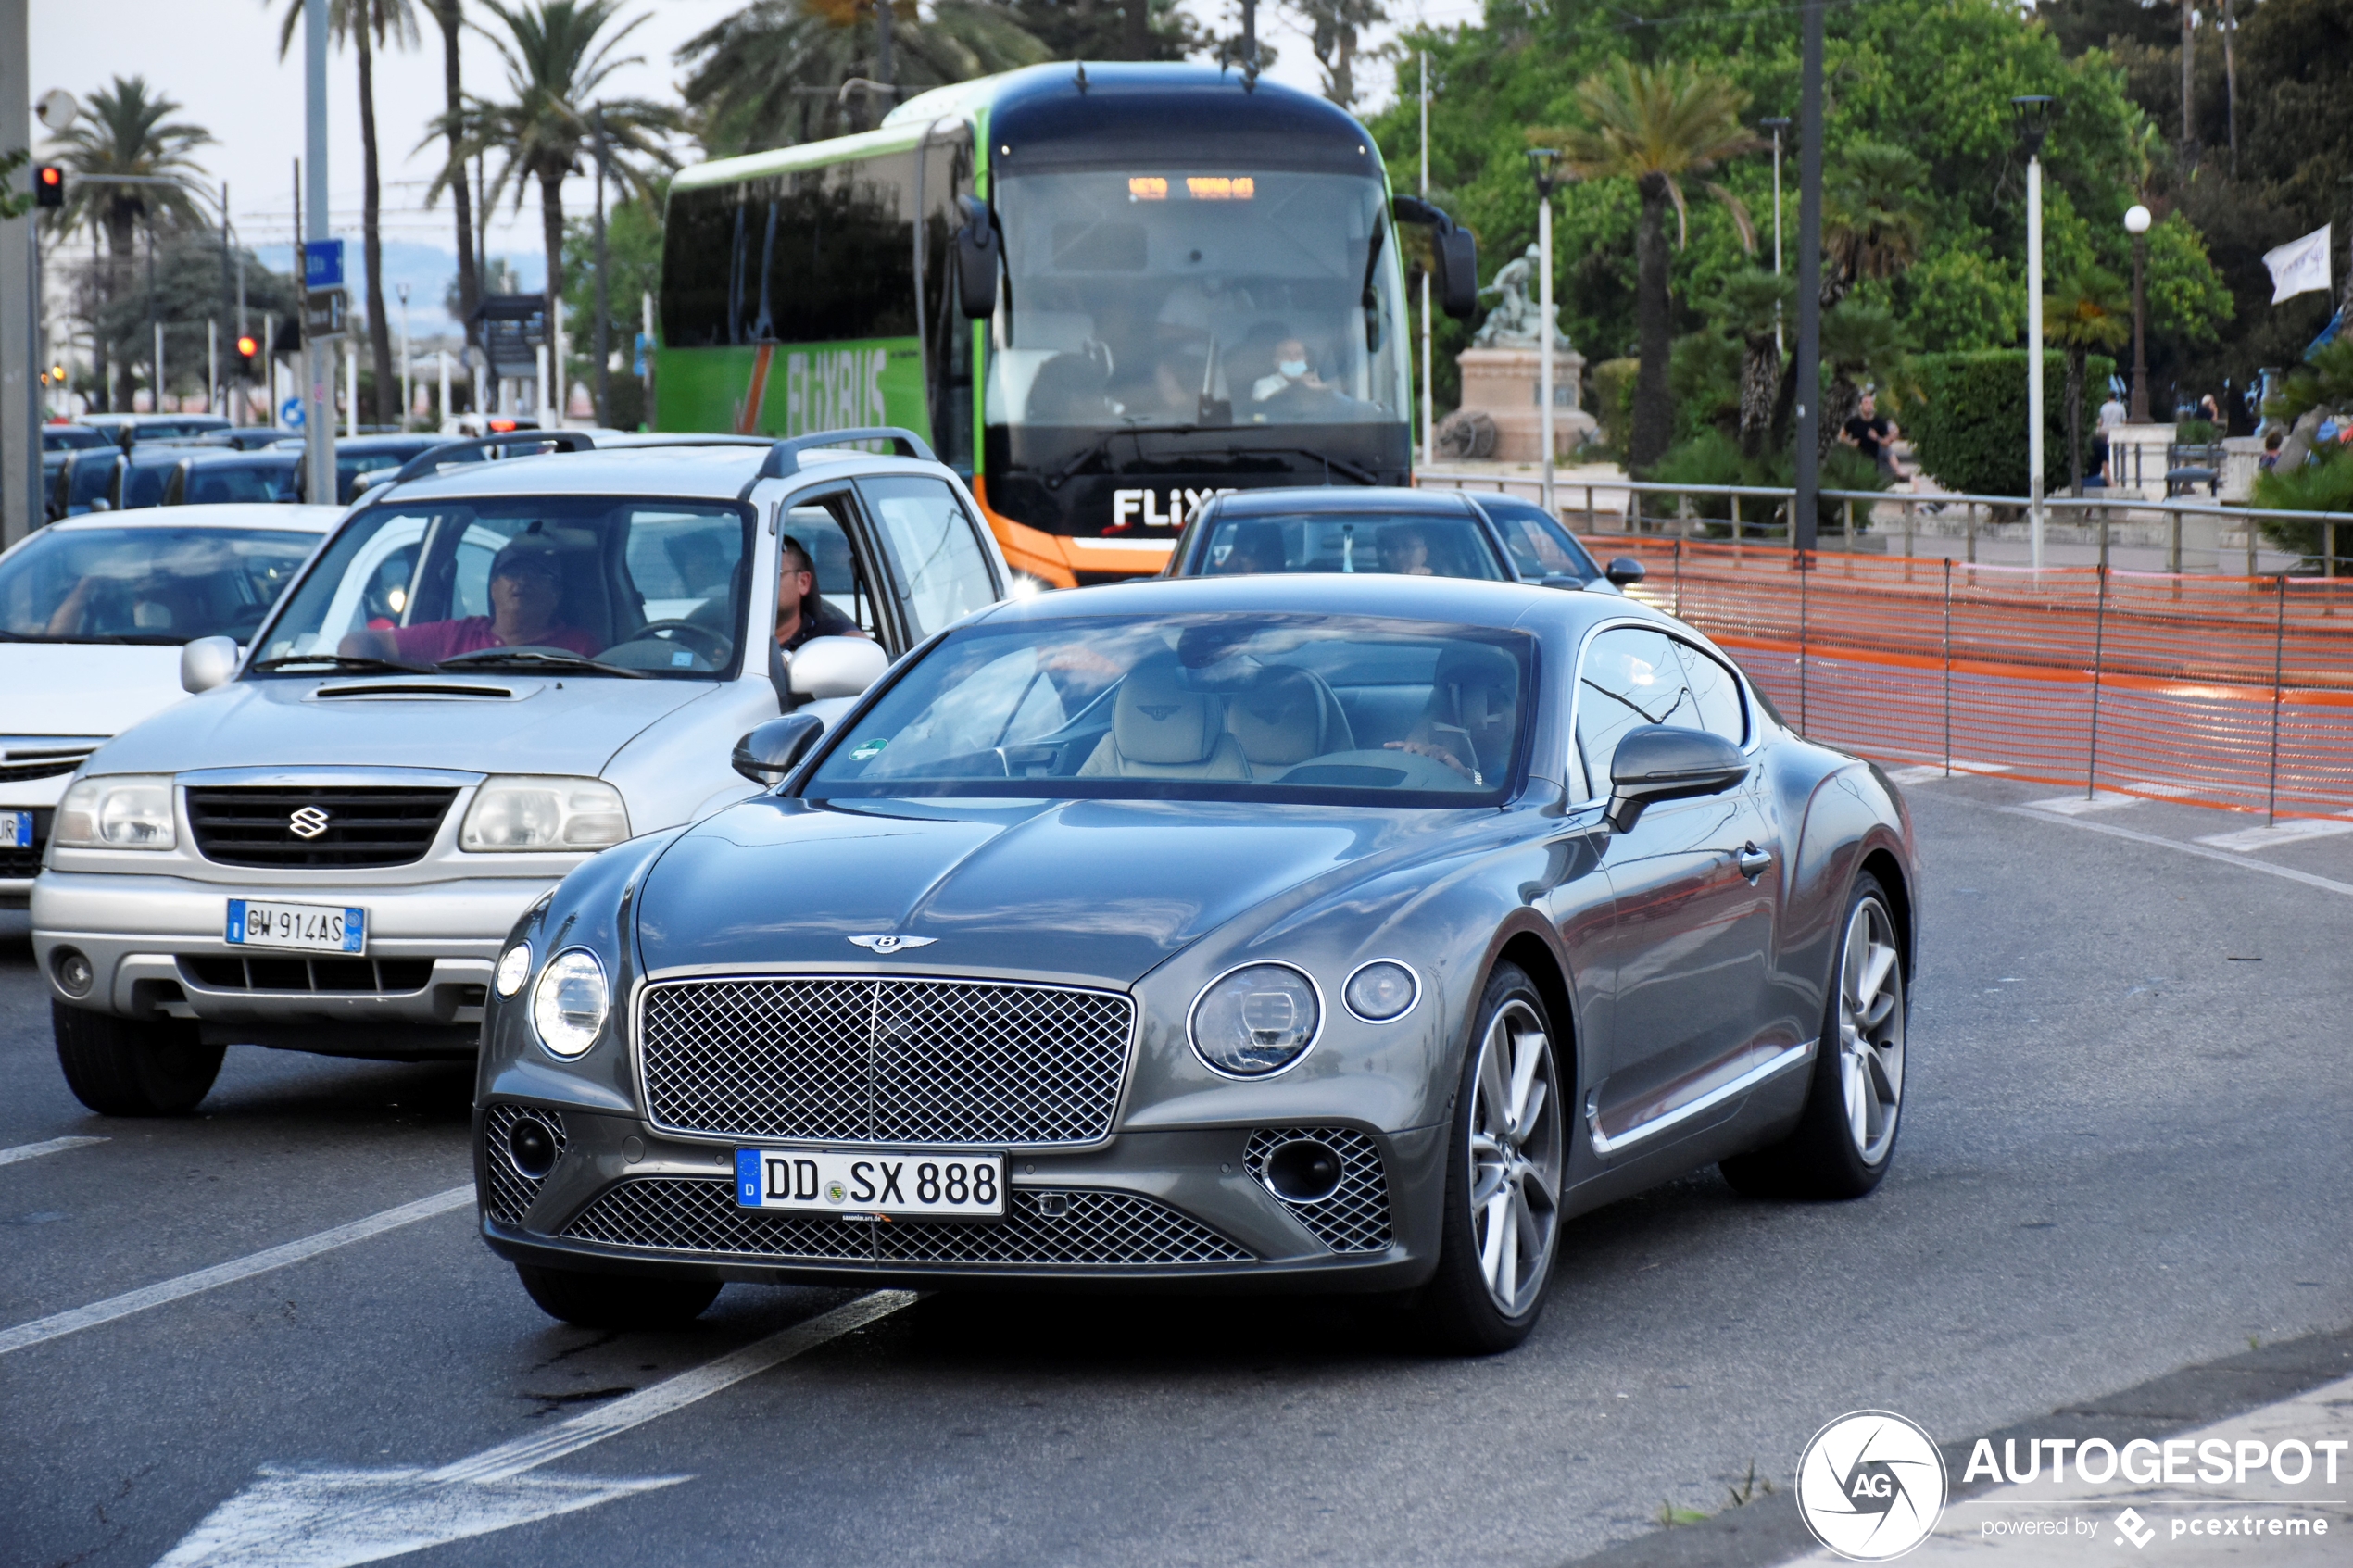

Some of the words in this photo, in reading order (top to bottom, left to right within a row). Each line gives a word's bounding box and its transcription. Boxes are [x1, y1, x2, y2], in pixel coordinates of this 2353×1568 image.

[745, 1183, 755, 1197] D
[765, 1158, 819, 1201] DD
[850, 1161, 905, 1204] SX
[916, 1162, 998, 1205] 888
